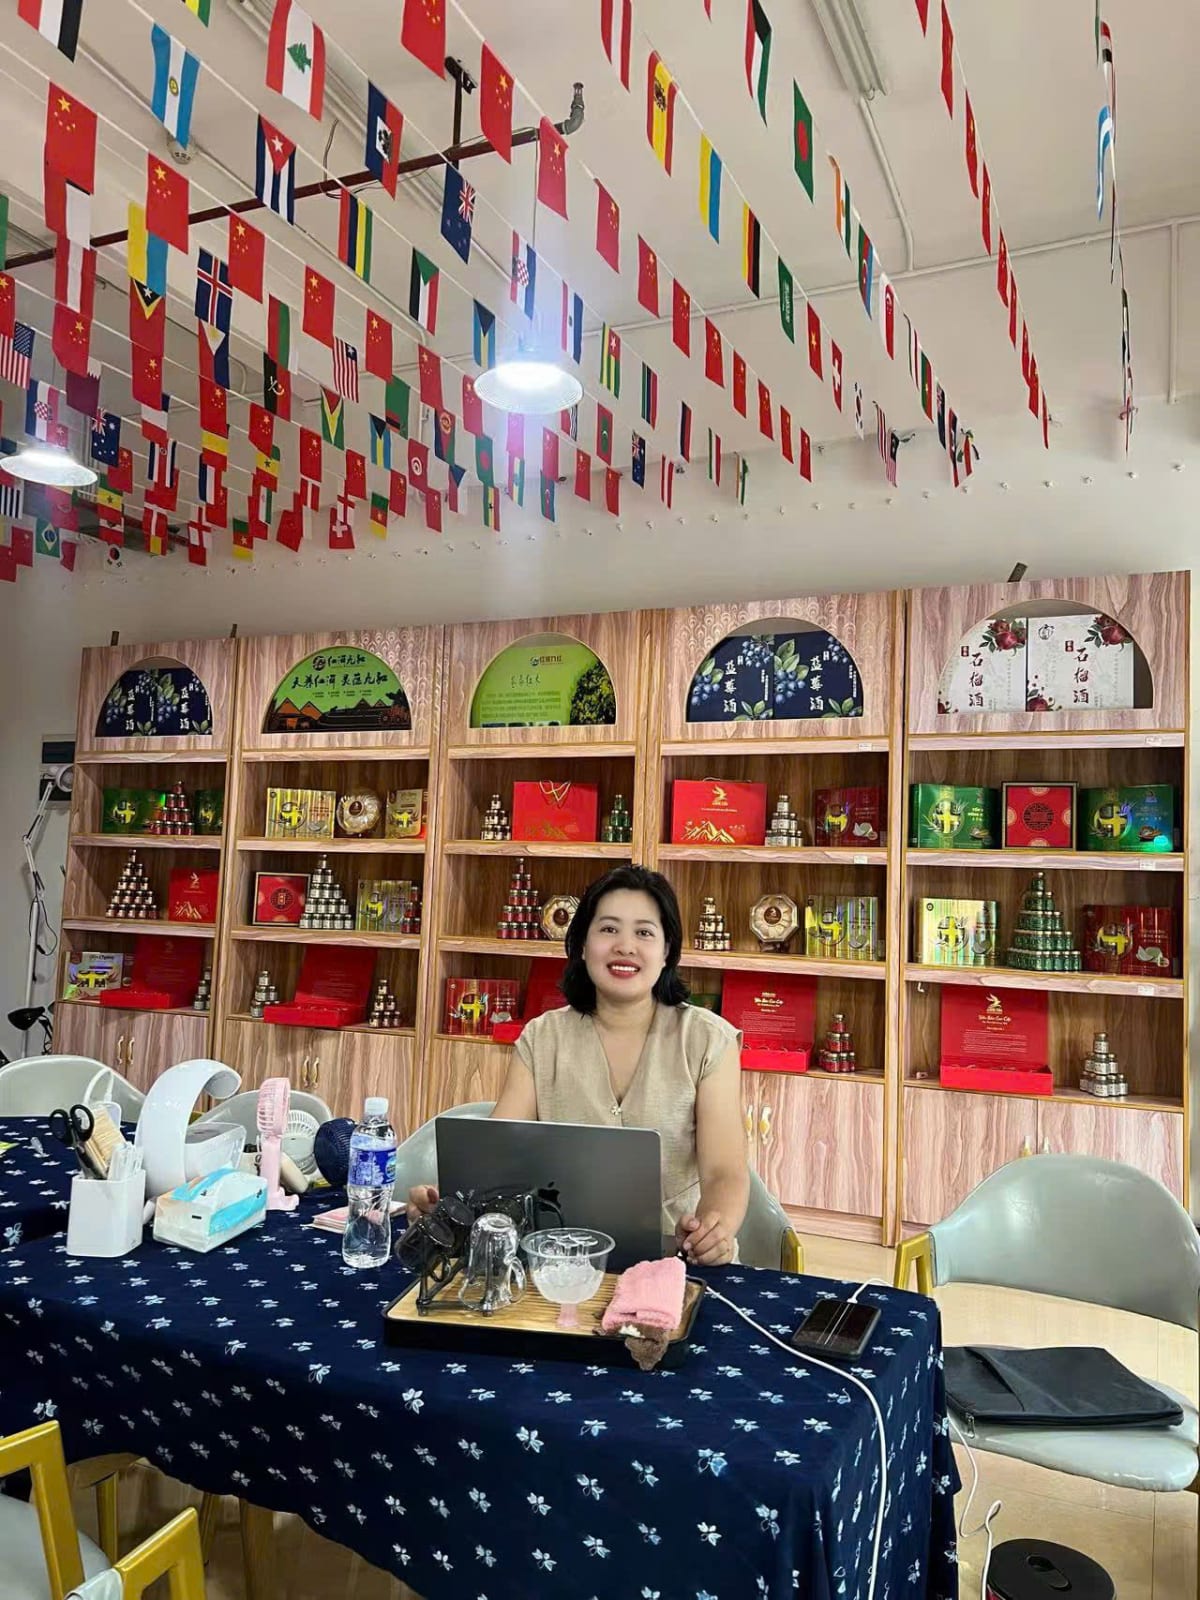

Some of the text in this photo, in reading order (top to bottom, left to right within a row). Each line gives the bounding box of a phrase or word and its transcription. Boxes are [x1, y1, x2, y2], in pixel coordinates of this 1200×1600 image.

[724, 660, 737, 713] 蓝莓酒
[810, 656, 824, 711] 蓝莓酒
